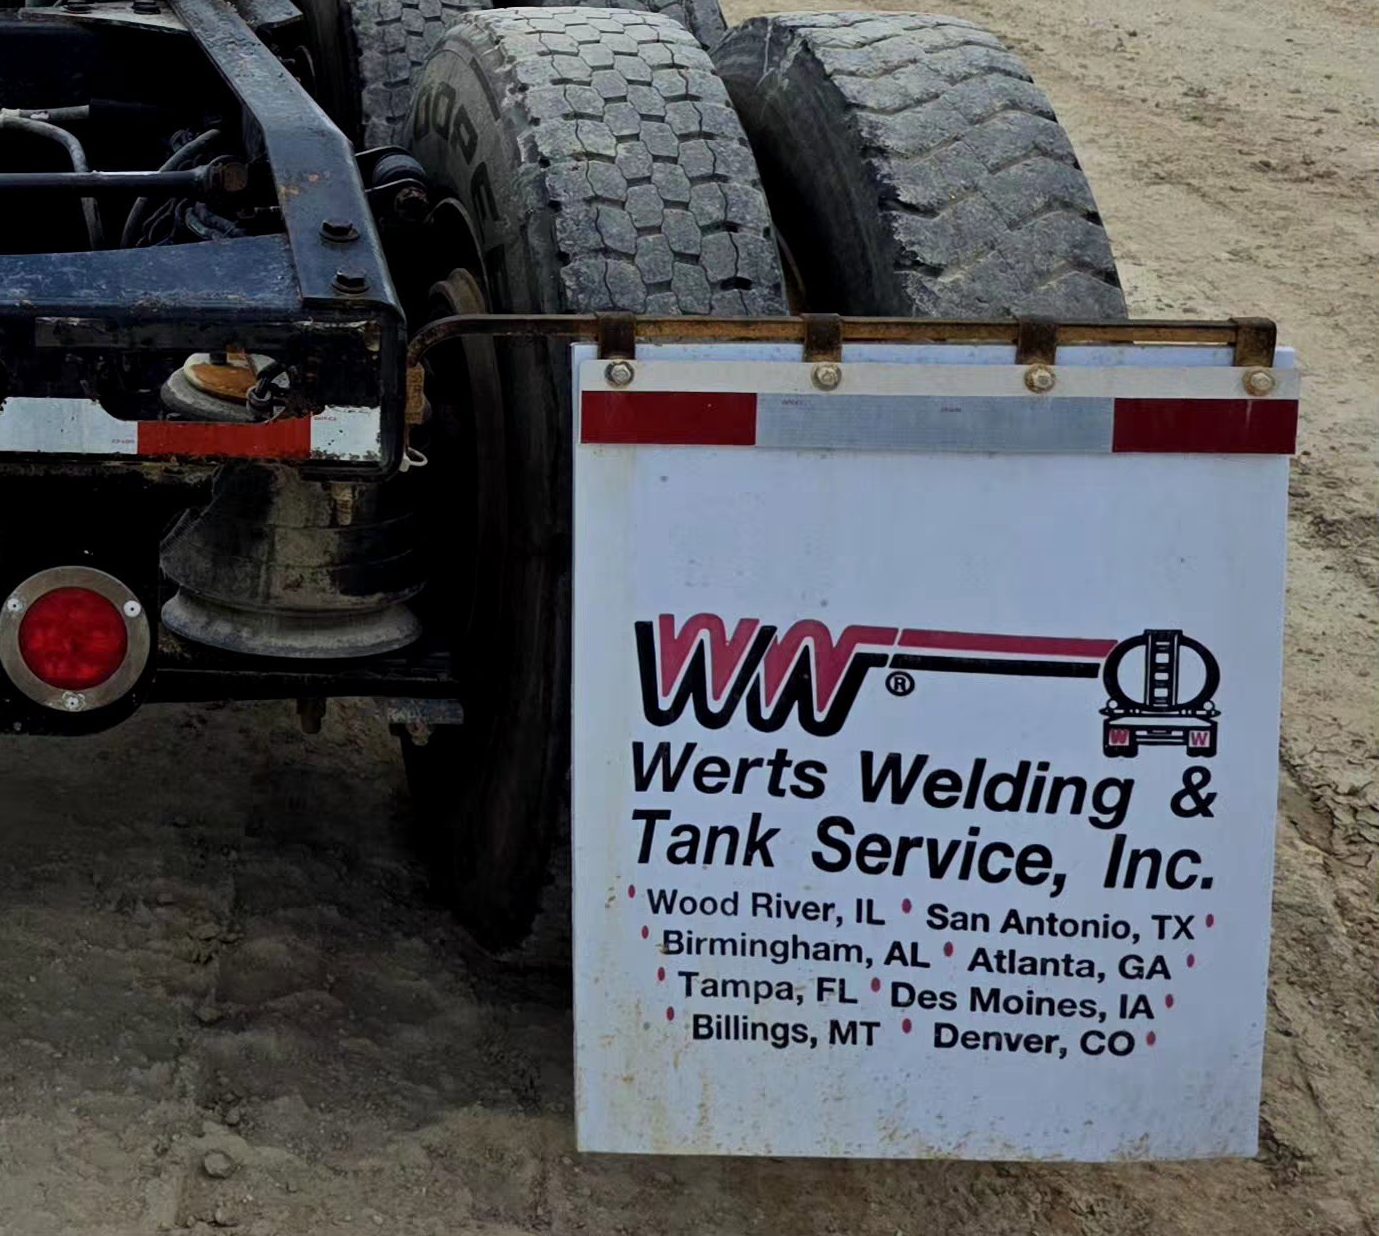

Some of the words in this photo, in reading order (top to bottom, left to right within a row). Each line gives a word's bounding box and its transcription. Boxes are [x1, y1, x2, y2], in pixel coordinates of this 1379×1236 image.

[631, 741, 827, 801] Werts
[860, 750, 1134, 830] Welding
[1170, 765, 1218, 819] &
[631, 808, 781, 868] Tank
[811, 815, 1067, 899] Service,
[1103, 833, 1214, 891] Inc.
[647, 888, 739, 917] Wood
[751, 891, 844, 928] River,
[855, 898, 885, 926] IL
[926, 903, 990, 933] San
[1000, 908, 1141, 945] Antonio,
[1151, 914, 1195, 941] TX
[662, 929, 873, 970] Birmingham,
[883, 940, 931, 969] AL
[967, 947, 1106, 984] Atlanta,
[1117, 953, 1172, 981] GA
[678, 970, 804, 1007] Tampa,
[816, 976, 858, 1005] FL
[890, 981, 958, 1012] Des
[969, 986, 1107, 1024] Moines,
[1119, 993, 1155, 1020] IA
[692, 1013, 818, 1050] Billings,
[828, 1019, 881, 1047] MT
[933, 1021, 1068, 1060] Denver,
[1079, 1029, 1136, 1057] CO
